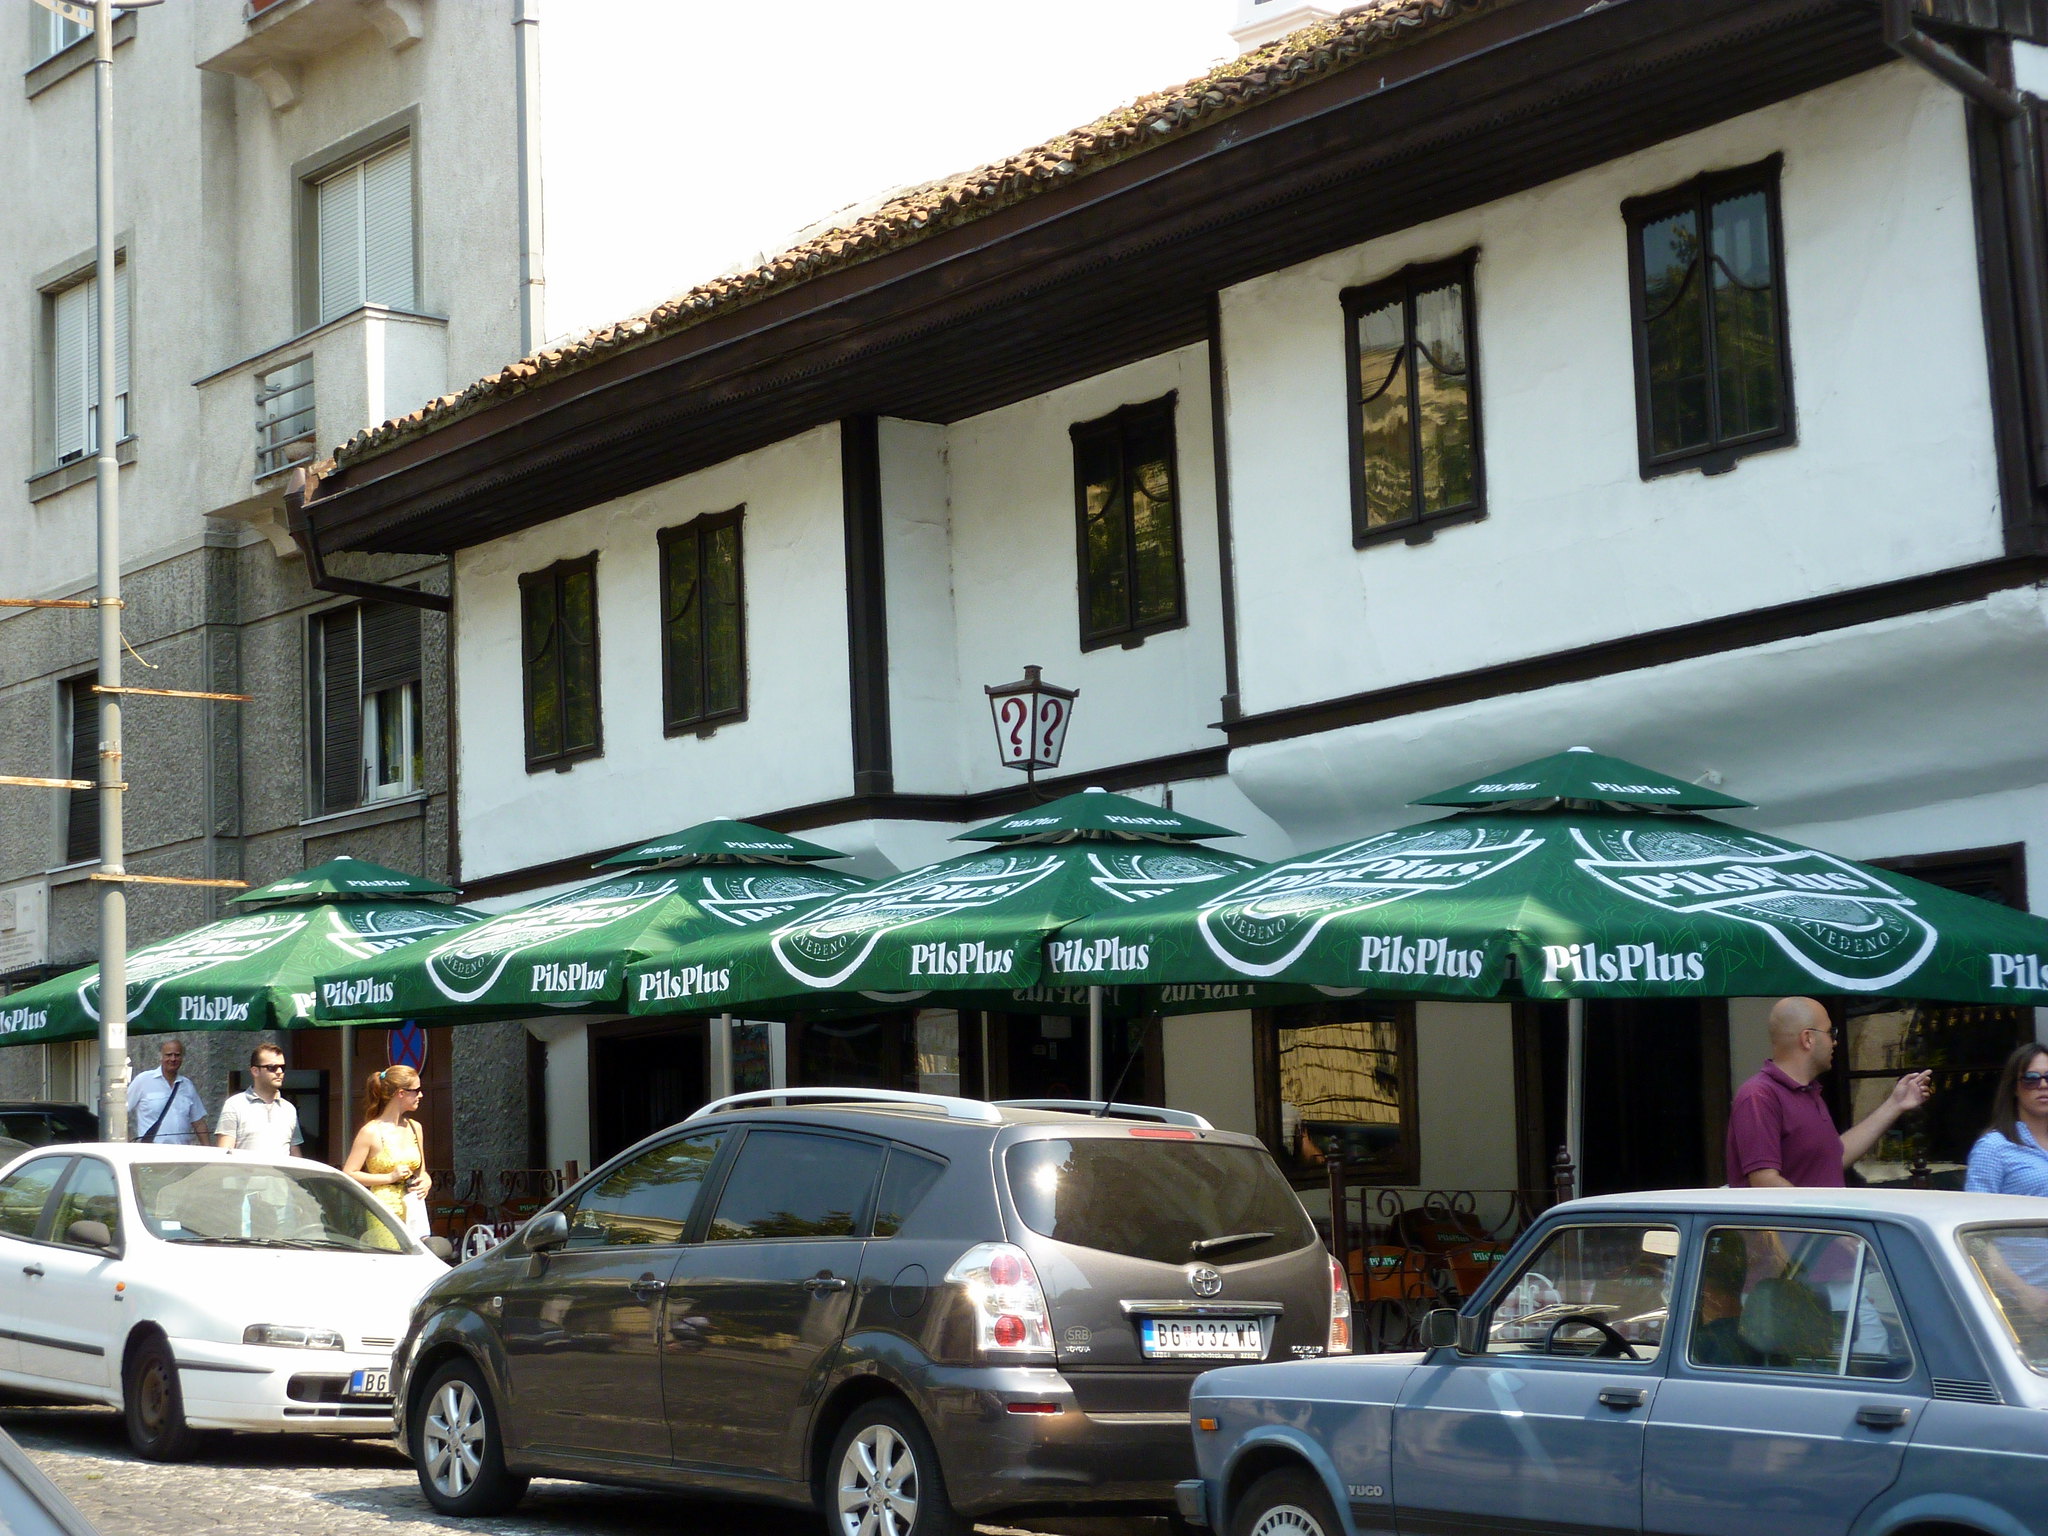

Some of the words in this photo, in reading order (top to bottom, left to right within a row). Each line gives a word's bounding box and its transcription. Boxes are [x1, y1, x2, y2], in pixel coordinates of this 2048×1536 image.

[1001, 697, 1028, 757] ?
[1041, 698, 1064, 758] ?
[1469, 782, 1541, 794] PilsPlus
[1590, 781, 1681, 795] PilsPlus
[1001, 816, 1063, 829] PilsPlus
[1104, 814, 1182, 826] PilsPlus
[724, 841, 794, 850] PilsPlus
[1244, 857, 1494, 896] PilsPlus
[1618, 864, 1870, 899] PilsPlus
[804, 881, 1021, 923] PilsPlus
[910, 941, 1014, 976] PilsPlus
[1049, 936, 1150, 973] PilsPlus
[1358, 934, 1485, 979] PilsPlus
[1541, 941, 1705, 985] PilsPlus
[323, 976, 394, 1008] PilsPlus
[530, 962, 608, 992] PilsPlus
[638, 964, 730, 1002] PilsPlus
[179, 995, 250, 1021] PilsPlus
[1067, 1330, 1089, 1340] SRB
[1158, 1323, 1181, 1347] BG
[365, 1373, 387, 1391] BG
[1348, 1485, 1383, 1497] YUGO
